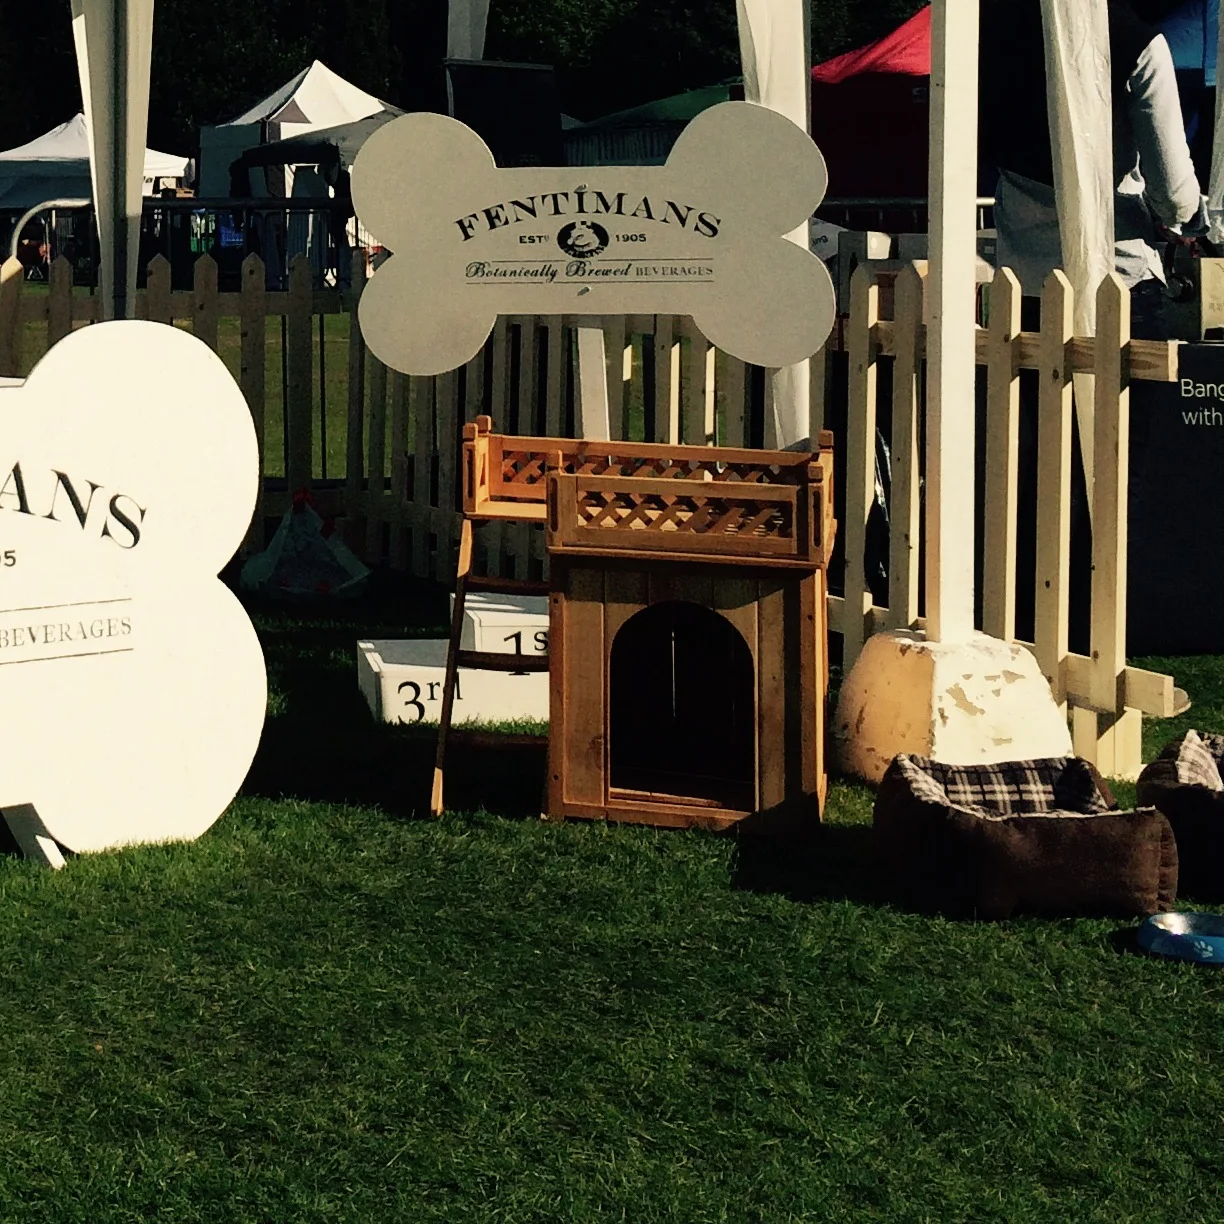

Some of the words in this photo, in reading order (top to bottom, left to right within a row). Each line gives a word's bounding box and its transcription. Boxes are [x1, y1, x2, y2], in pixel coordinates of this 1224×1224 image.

[454, 189, 722, 241] FENTIMANS
[616, 233, 647, 243] 1905
[466, 261, 558, 284] Botanically
[565, 258, 631, 278] Brewed
[635, 265, 714, 277] BEVERAGES
[1181, 407, 1224, 426] with
[503, 630, 549, 675] 1s
